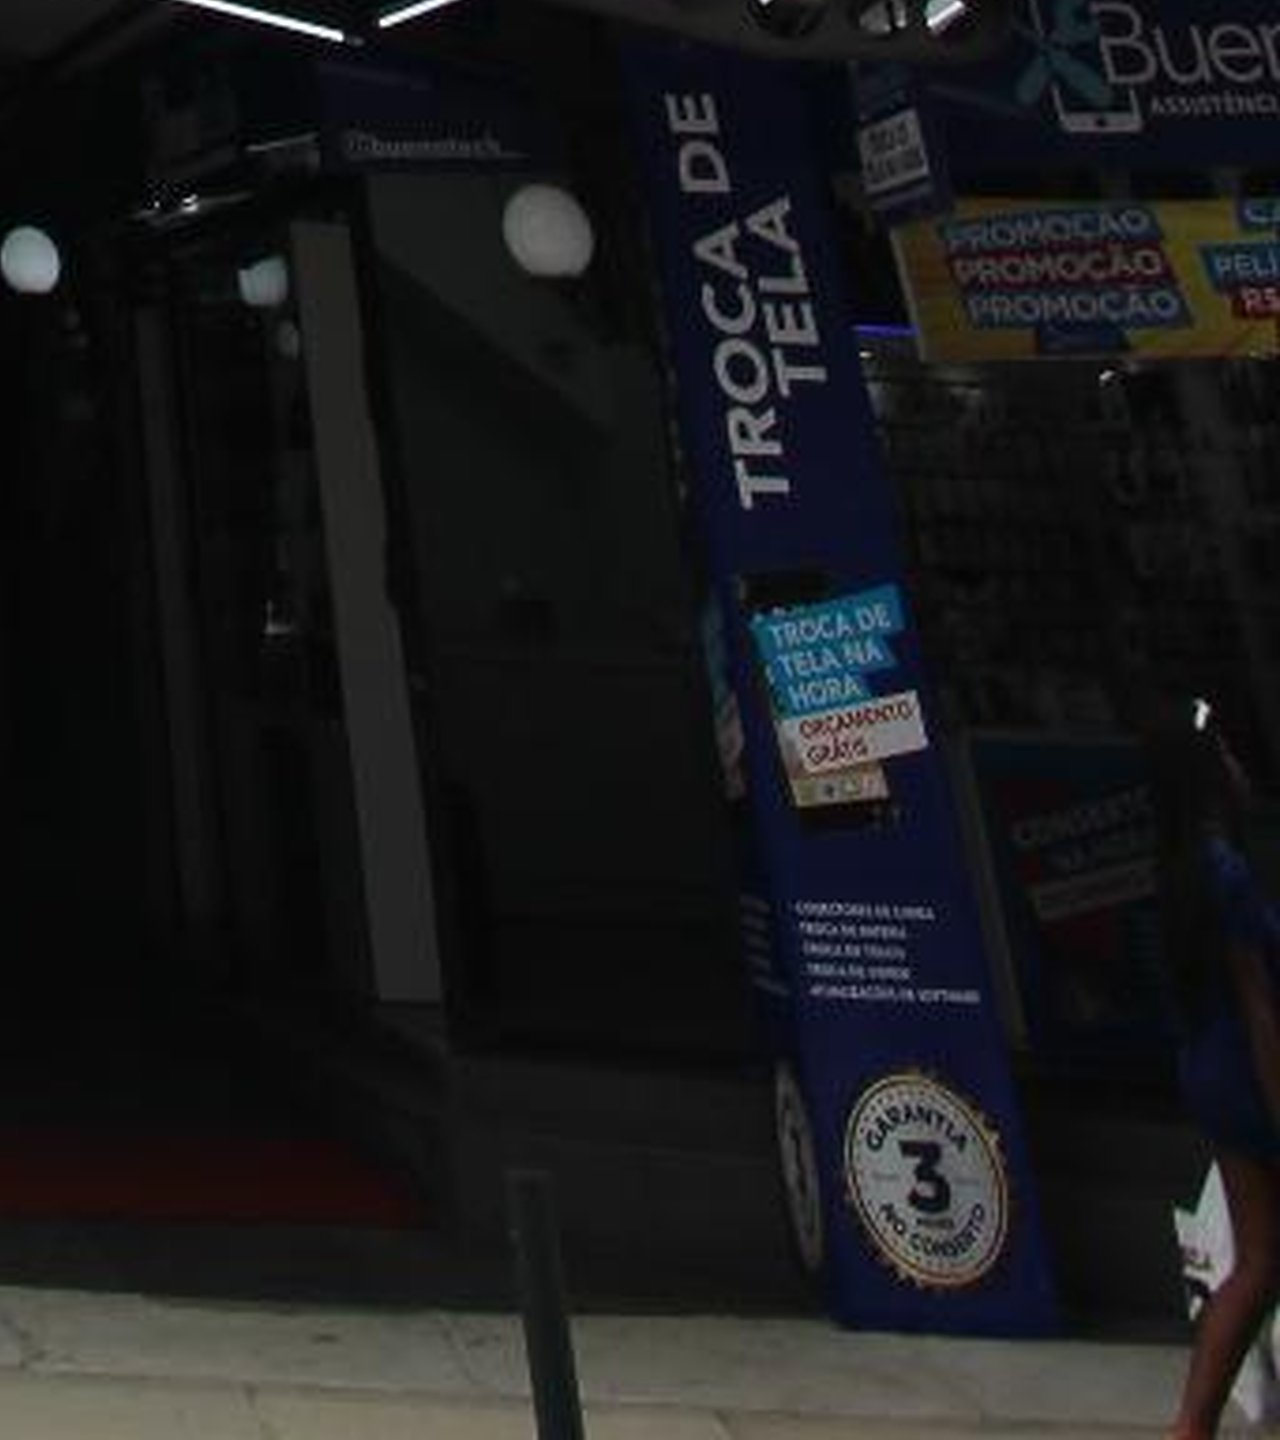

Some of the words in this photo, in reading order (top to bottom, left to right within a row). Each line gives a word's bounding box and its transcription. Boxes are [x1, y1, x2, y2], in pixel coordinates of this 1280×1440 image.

[665, 90, 732, 194] DE
[745, 195, 830, 400] TELA
[692, 222, 793, 512] TROCA
[768, 612, 852, 649] TROCA
[856, 603, 892, 633] DE
[777, 651, 839, 679] TELA
[845, 638, 883, 666] NA
[788, 674, 863, 711] HORA
[798, 700, 914, 739] ORÇAMENTO
[866, 1104, 969, 1153] GARANTIA
[898, 1139, 951, 1214] 3
[879, 1202, 908, 1237] NO
[910, 1203, 986, 1258] CONSERTO
